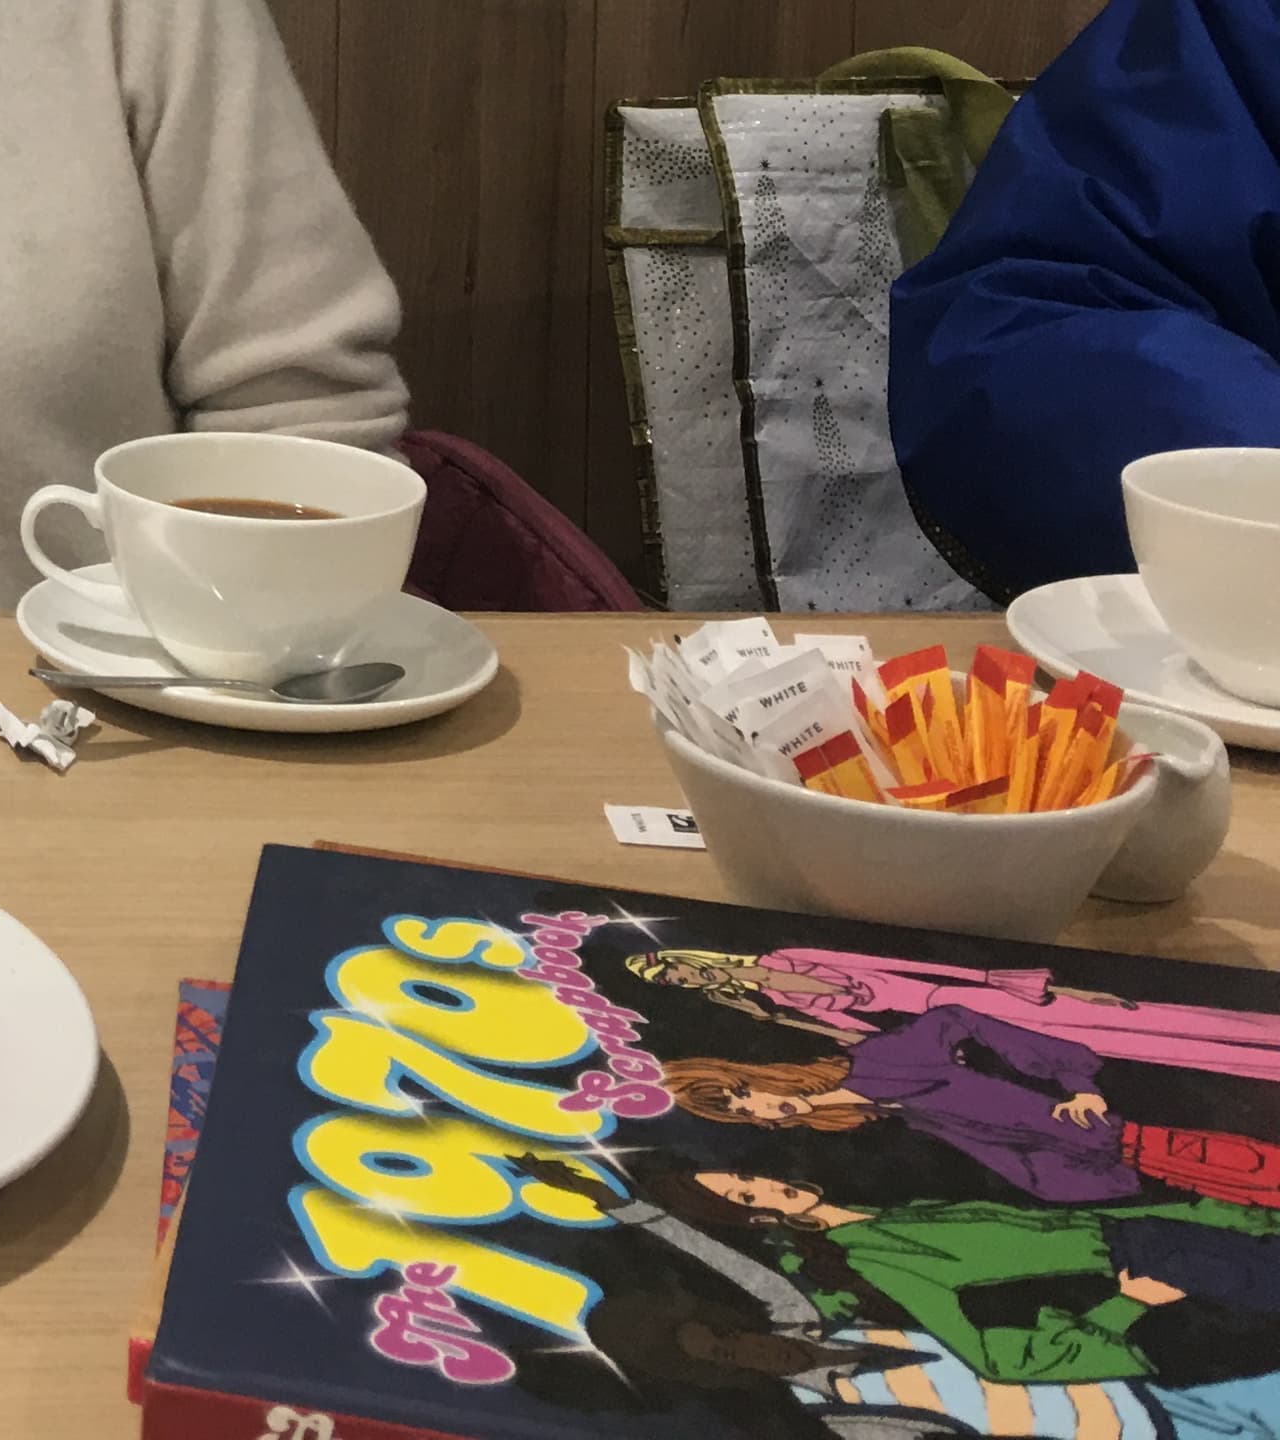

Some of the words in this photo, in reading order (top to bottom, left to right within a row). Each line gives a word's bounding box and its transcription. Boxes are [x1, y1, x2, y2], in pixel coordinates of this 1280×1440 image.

[736, 646, 771, 659] WHITE
[759, 681, 808, 709] WHITE
[778, 721, 824, 757] WHITE
[515, 910, 675, 1117] Scrapbook
[287, 913, 630, 1343] 1970s
[370, 1260, 516, 1385] The
